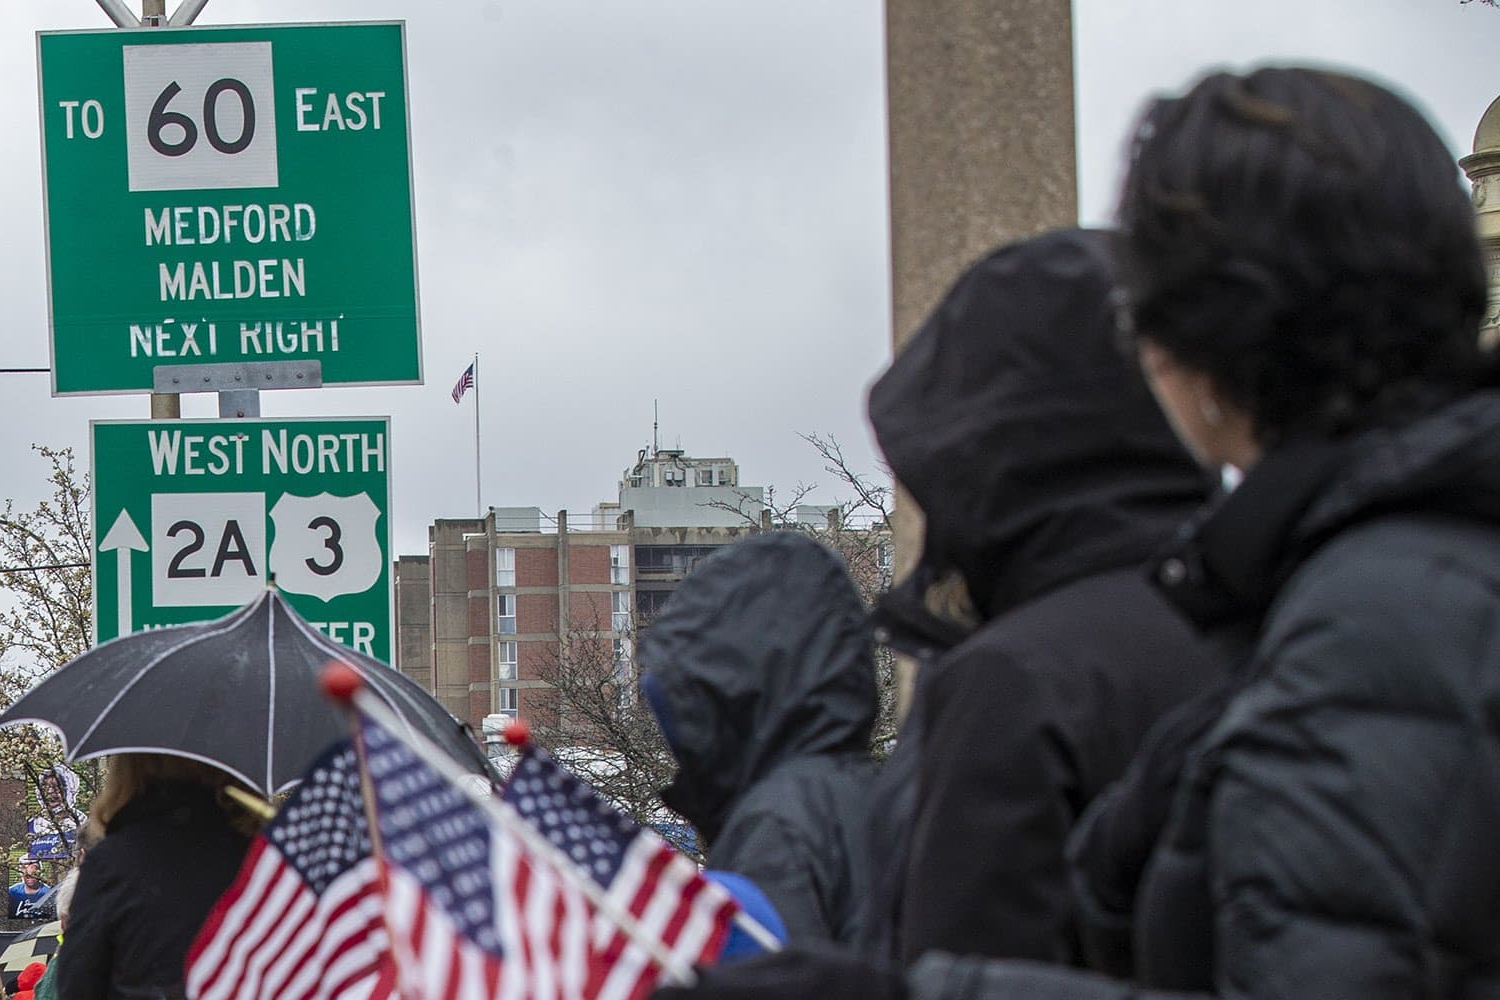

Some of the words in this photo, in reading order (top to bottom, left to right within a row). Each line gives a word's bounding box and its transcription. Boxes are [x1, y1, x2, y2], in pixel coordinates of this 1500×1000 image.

[59, 100, 105, 140] TO
[146, 77, 256, 158] 60
[294, 87, 386, 132] EAST
[144, 203, 317, 247] MEDFORD
[158, 258, 307, 302] MALDEN
[129, 318, 218, 358] NEXT
[239, 314, 345, 355] RIGHT
[148, 429, 250, 476] WEST
[261, 428, 385, 475] NORTH
[165, 519, 258, 579] 2A
[304, 516, 344, 577] 3
